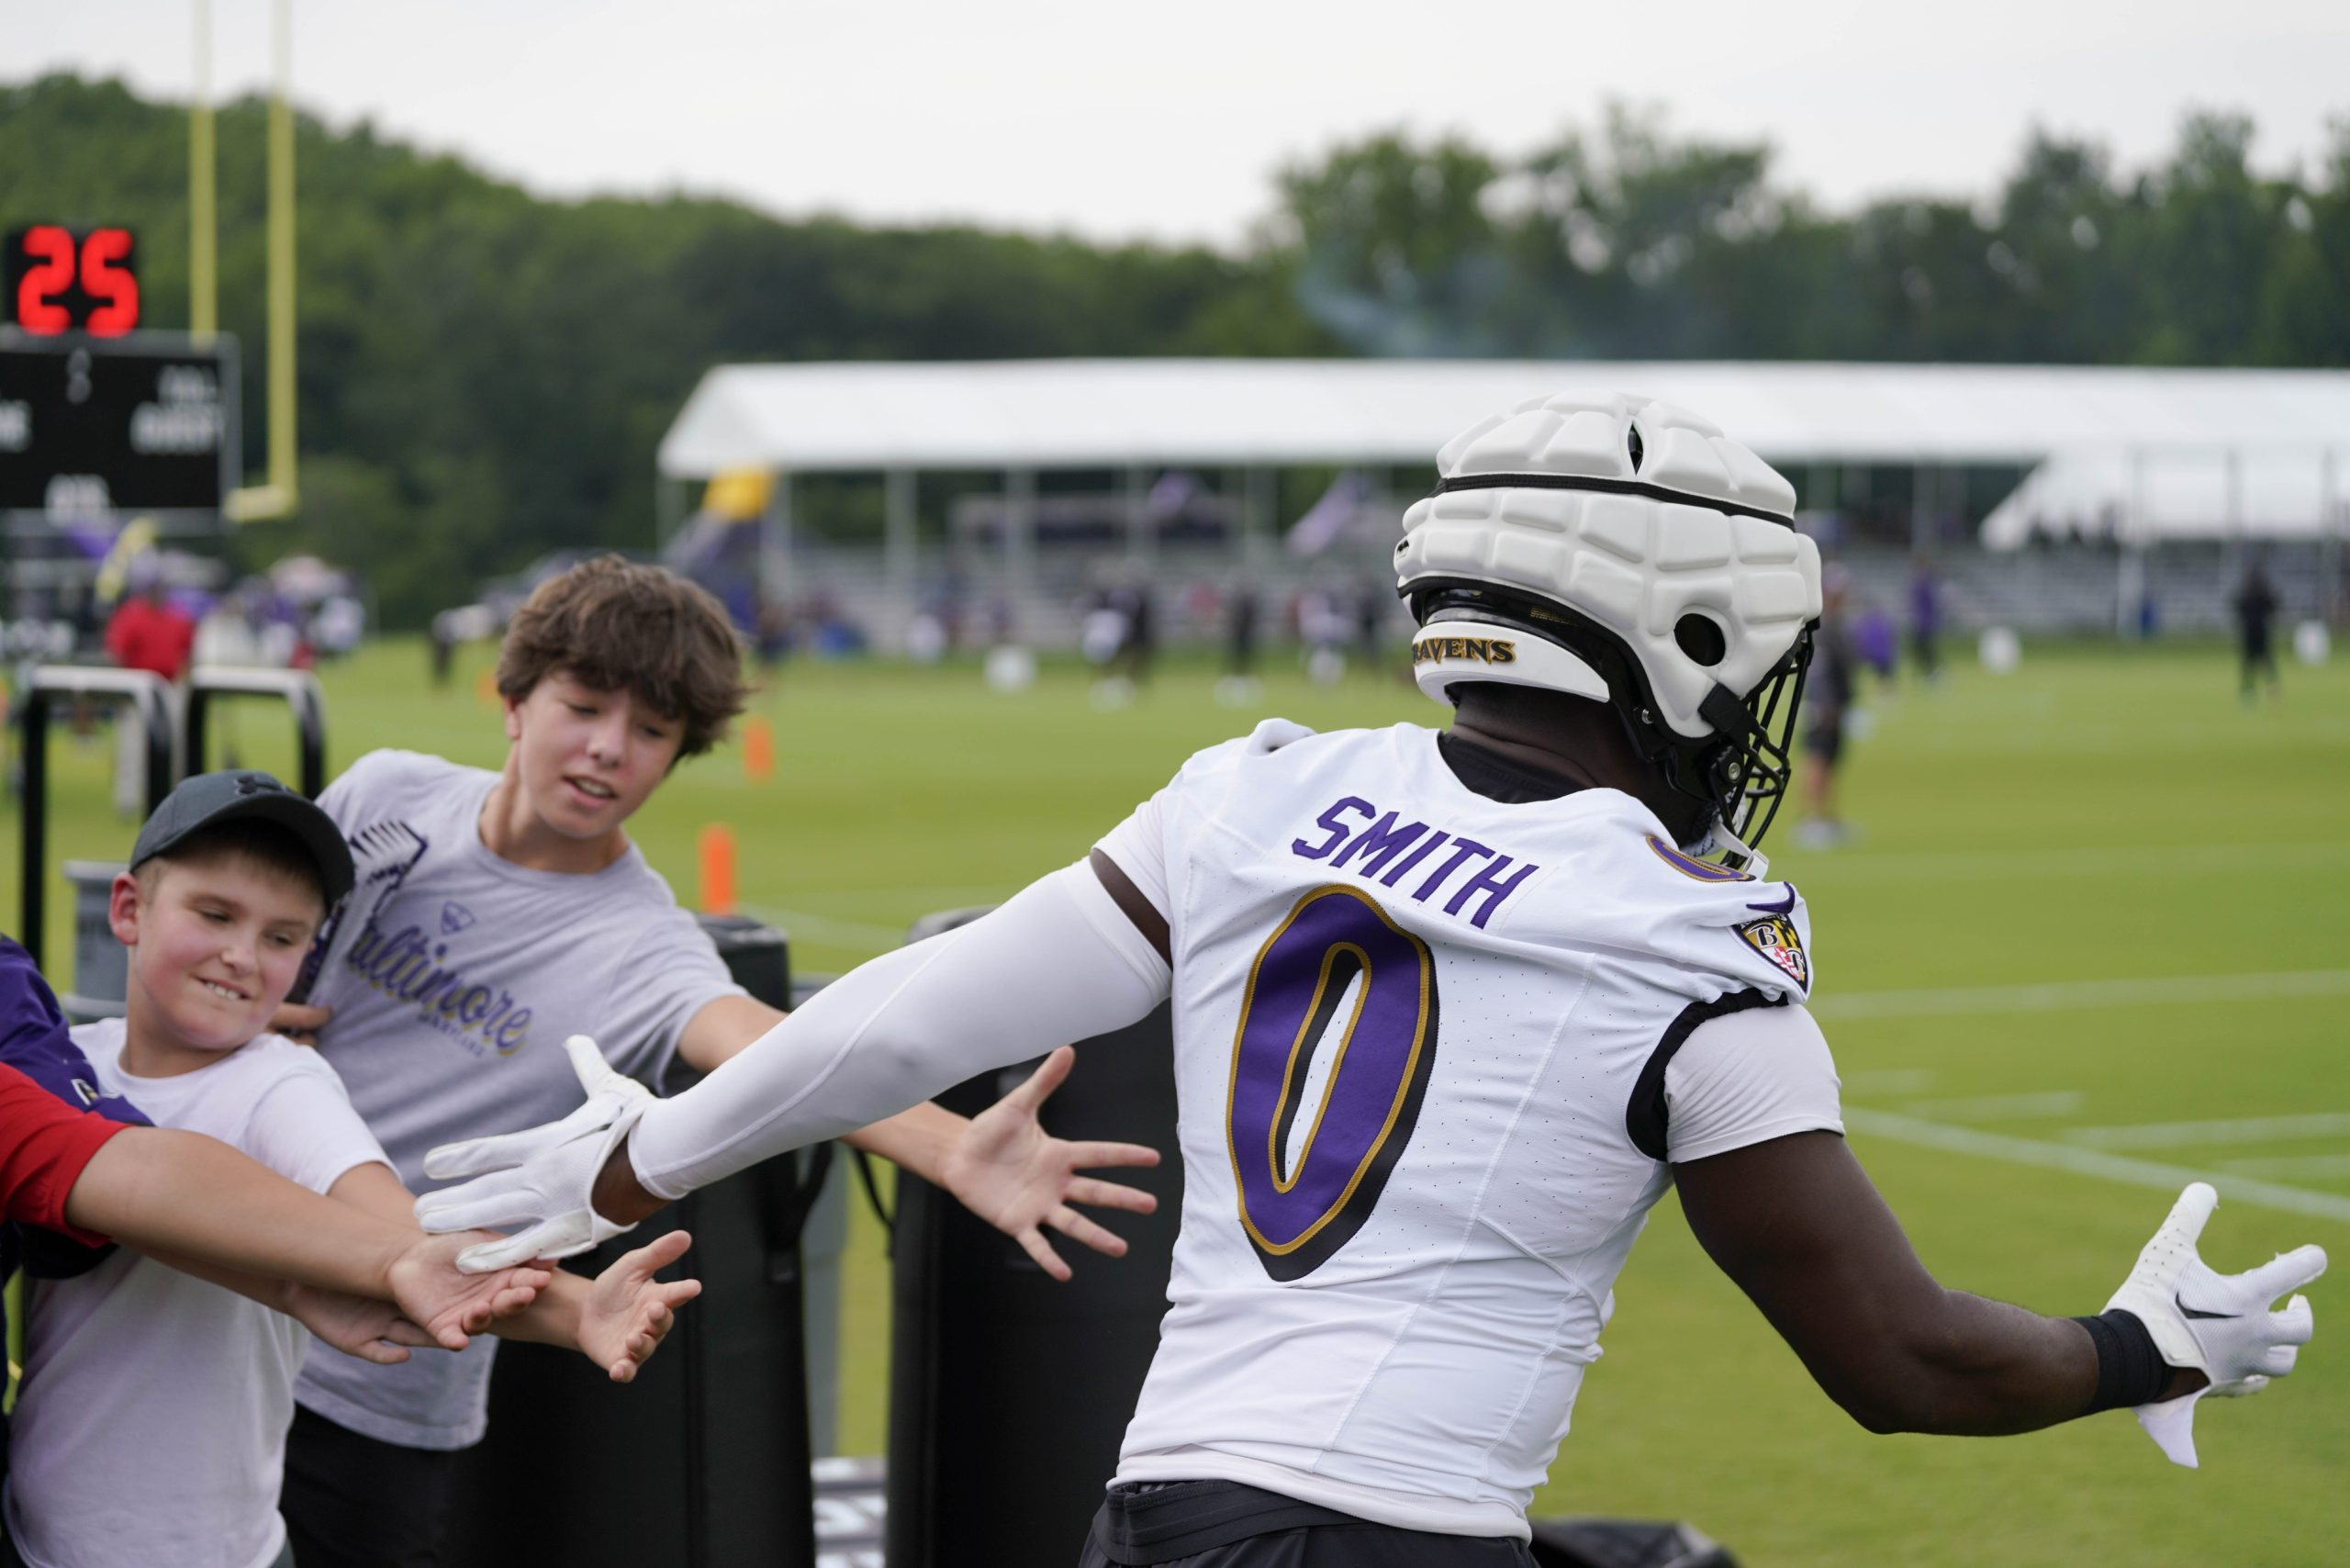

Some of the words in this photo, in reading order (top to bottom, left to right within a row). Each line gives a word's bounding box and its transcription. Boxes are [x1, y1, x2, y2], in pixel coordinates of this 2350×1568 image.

[17, 225, 139, 338] 25
[1292, 796, 1539, 930] SMITH
[1226, 882, 1439, 1282] 0
